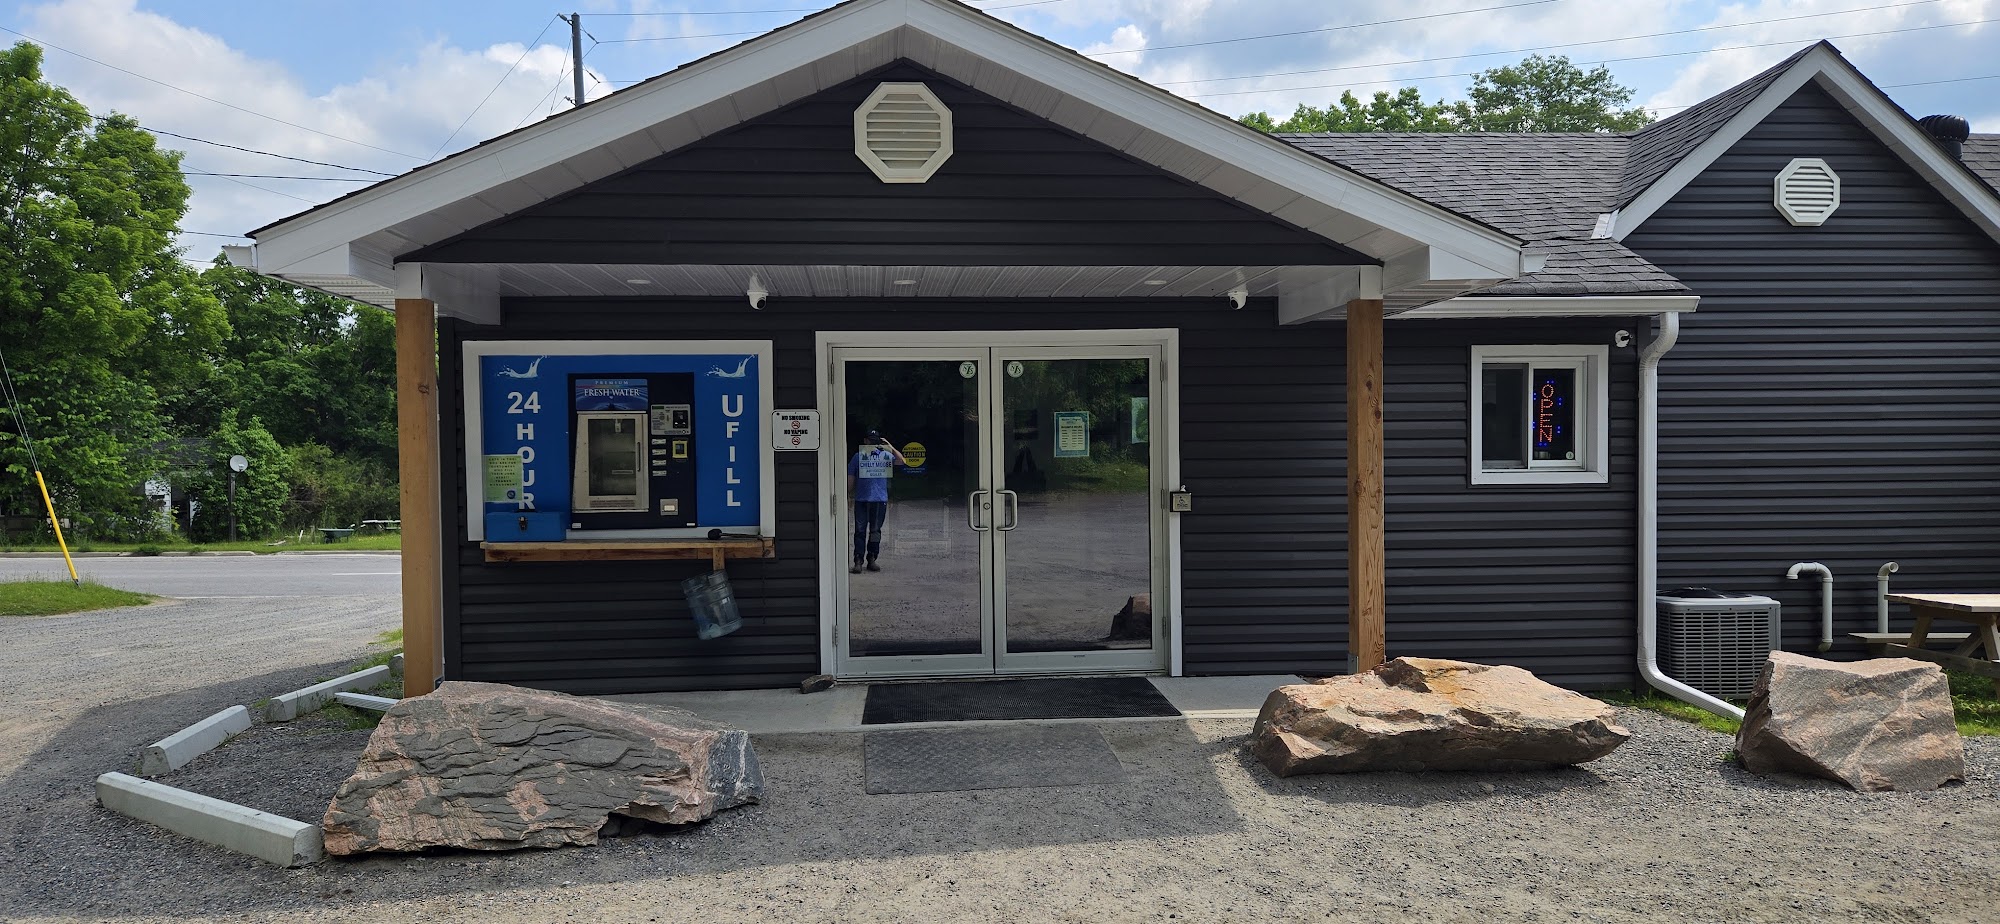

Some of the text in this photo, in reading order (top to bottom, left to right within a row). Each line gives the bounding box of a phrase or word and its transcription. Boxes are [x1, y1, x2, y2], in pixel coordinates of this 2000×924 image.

[507, 391, 541, 414] 24
[584, 388, 640, 397] FRESH WATER
[1540, 384, 1554, 442] OPEN
[516, 423, 536, 510] HOUR
